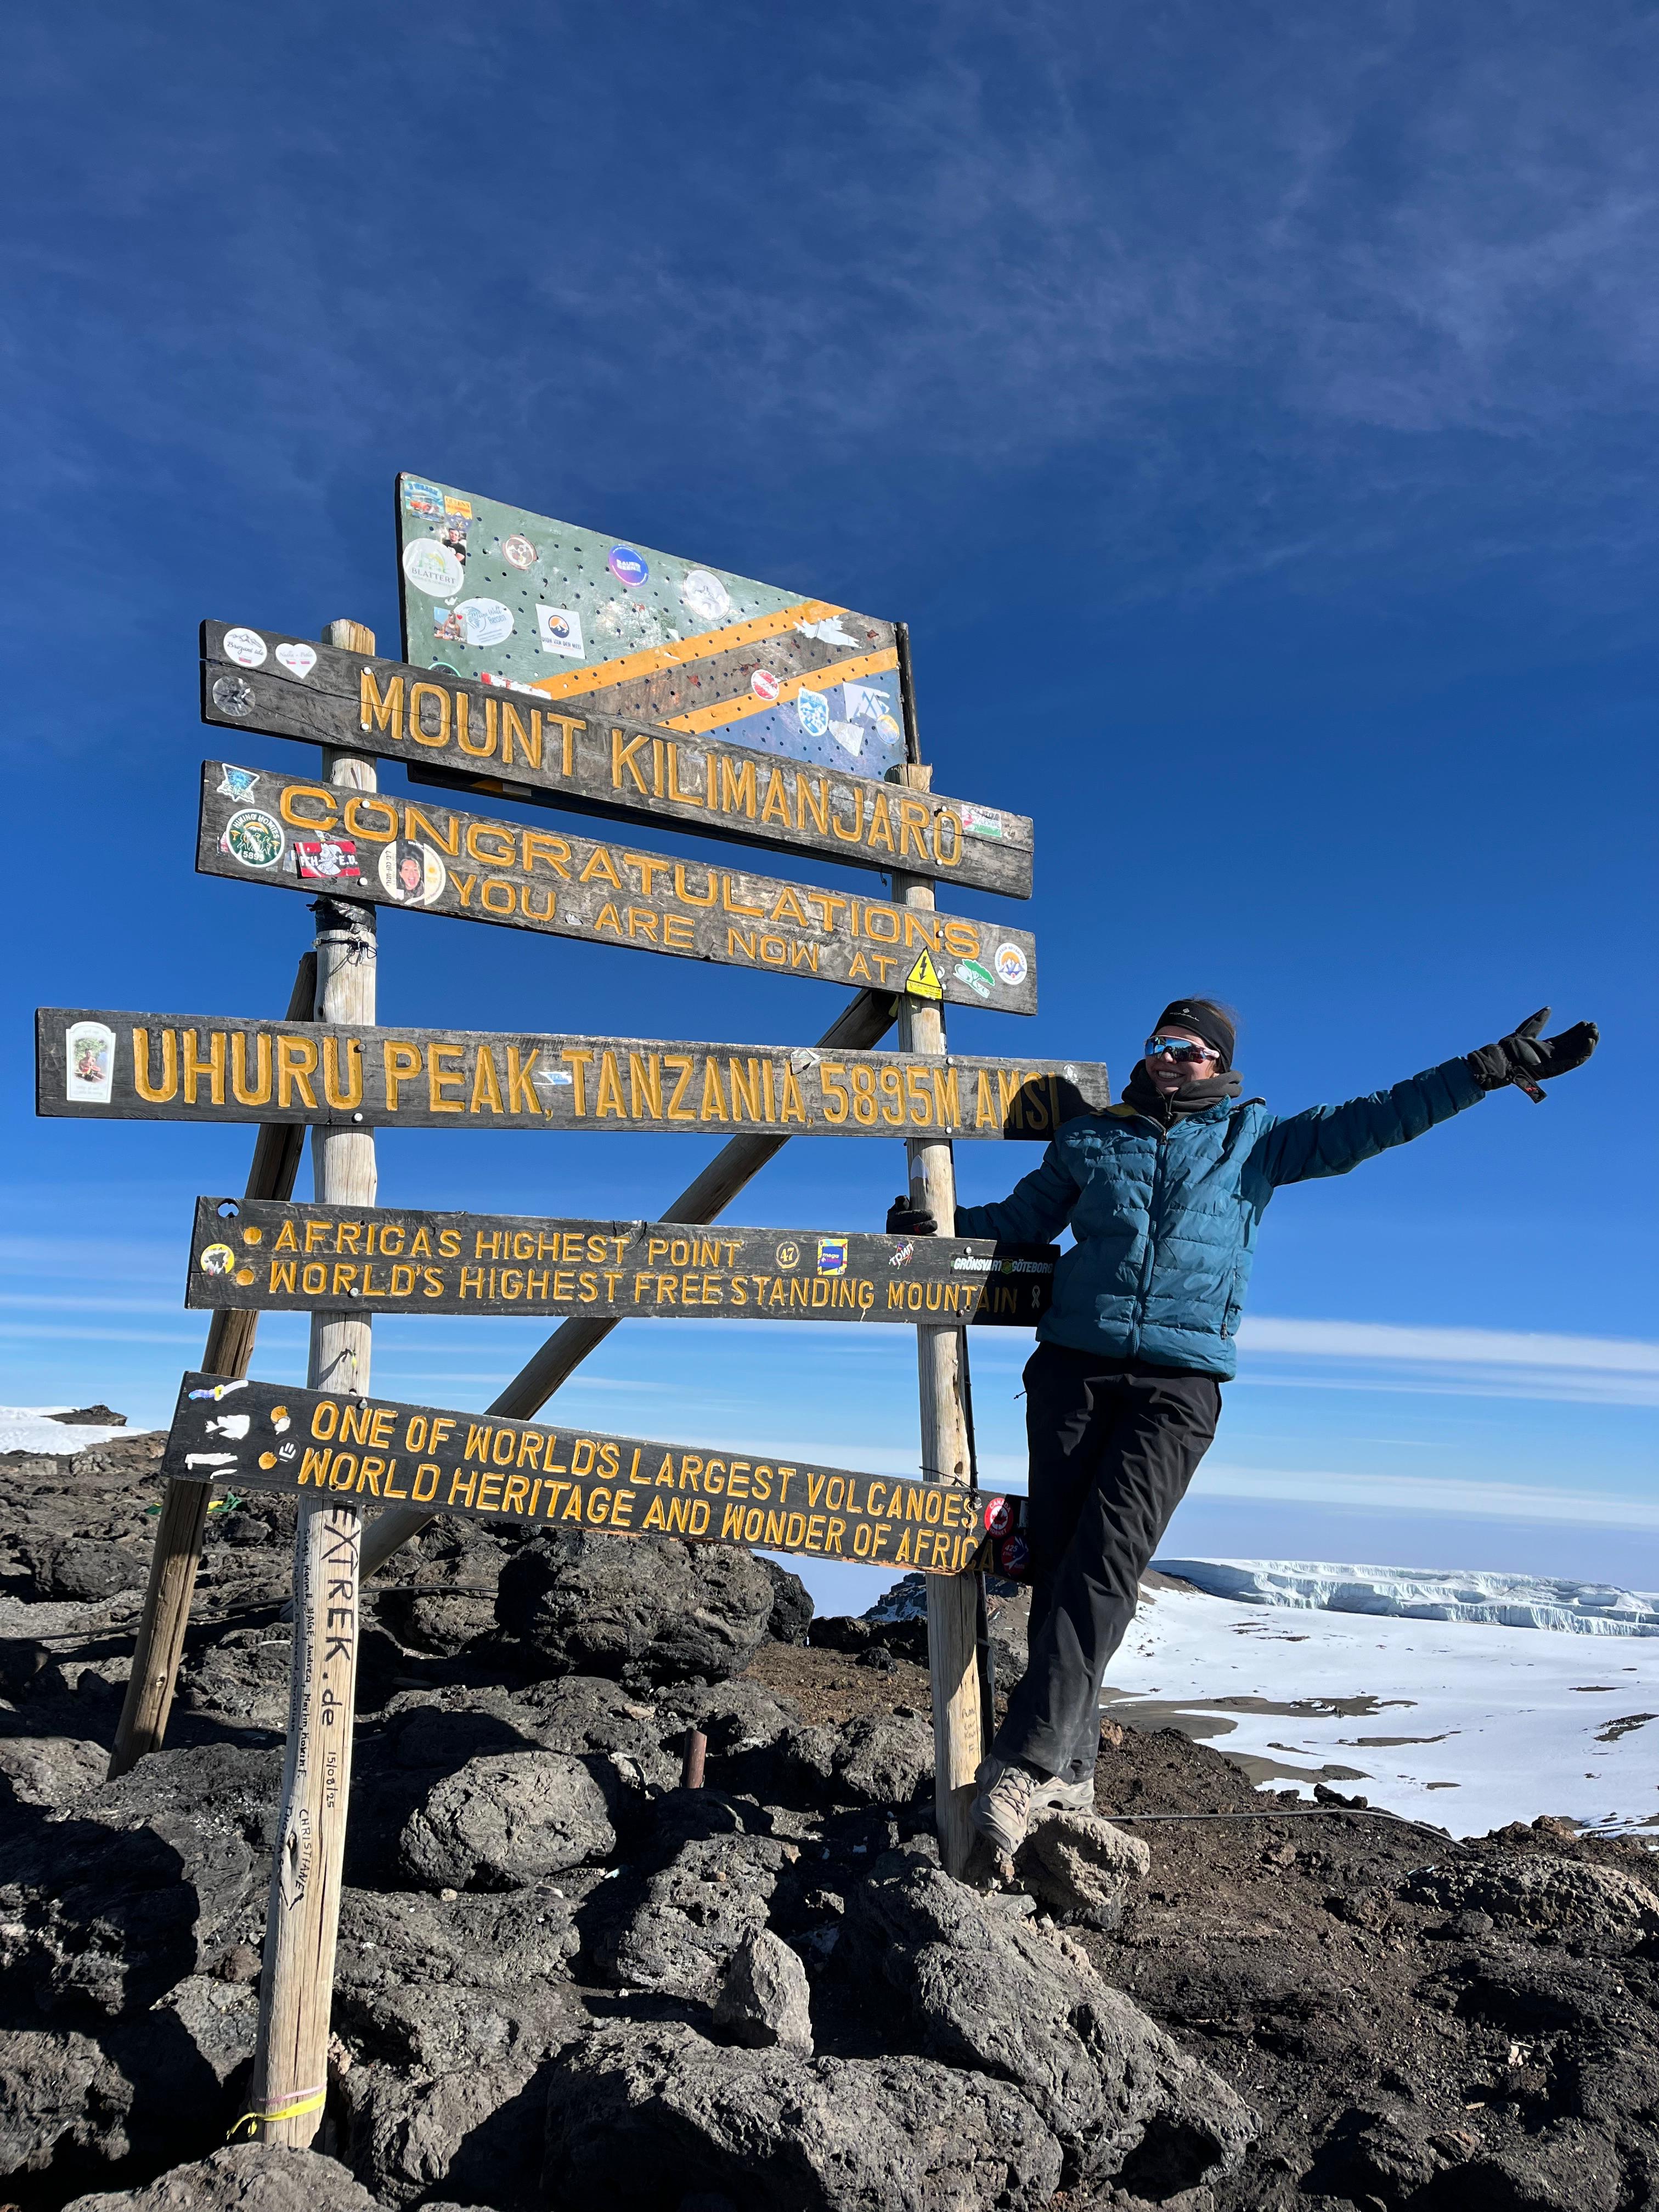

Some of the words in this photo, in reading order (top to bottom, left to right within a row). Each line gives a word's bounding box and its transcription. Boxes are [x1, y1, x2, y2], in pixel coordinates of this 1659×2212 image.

[411, 567, 456, 584] BLATTERT
[360, 669, 586, 777] MOUNT
[612, 728, 962, 866] KILIMANJARO
[233, 813, 257, 829] HIKING
[258, 814, 280, 839] HOMIES
[280, 785, 980, 960] CONGRATULATIONS
[448, 870, 556, 921] YOU
[594, 903, 695, 949] ARE
[728, 928, 819, 972] NOW
[849, 951, 898, 983] AT
[133, 1028, 363, 1110] UHURU
[385, 1039, 553, 1121] PEAK,
[820, 1062, 961, 1128] 5895M
[975, 1069, 1063, 1130] AMSL
[274, 1220, 462, 1257] AFRICAS
[475, 1231, 630, 1264] HIGHEST
[648, 1237, 743, 1268] POINT
[780, 1247, 794, 1262] 47
[1012, 1259, 1053, 1274] GÖTEBORG
[269, 1261, 444, 1297] WORLD'S
[459, 1266, 624, 1304] HIGHEST
[888, 1281, 1017, 1313] MOUNTAIN
[311, 1401, 398, 1449] ONE
[405, 1415, 456, 1455] OF
[464, 1423, 621, 1480] WORLD'S
[630, 1448, 797, 1503] LARGEST
[807, 1472, 978, 1530] VOLCANOES
[297, 1447, 441, 1502] WORLD
[448, 1467, 636, 1527] HERITAGE
[642, 1494, 711, 1536] AND
[721, 1503, 847, 1554] WONDER
[854, 1522, 891, 1558] OF
[895, 1527, 994, 1573] AFRICA
[989, 1499, 1011, 1513] CANADA
[277, 1805, 294, 1866] THOMAS
[295, 1809, 312, 1891] CHRISTIANE
